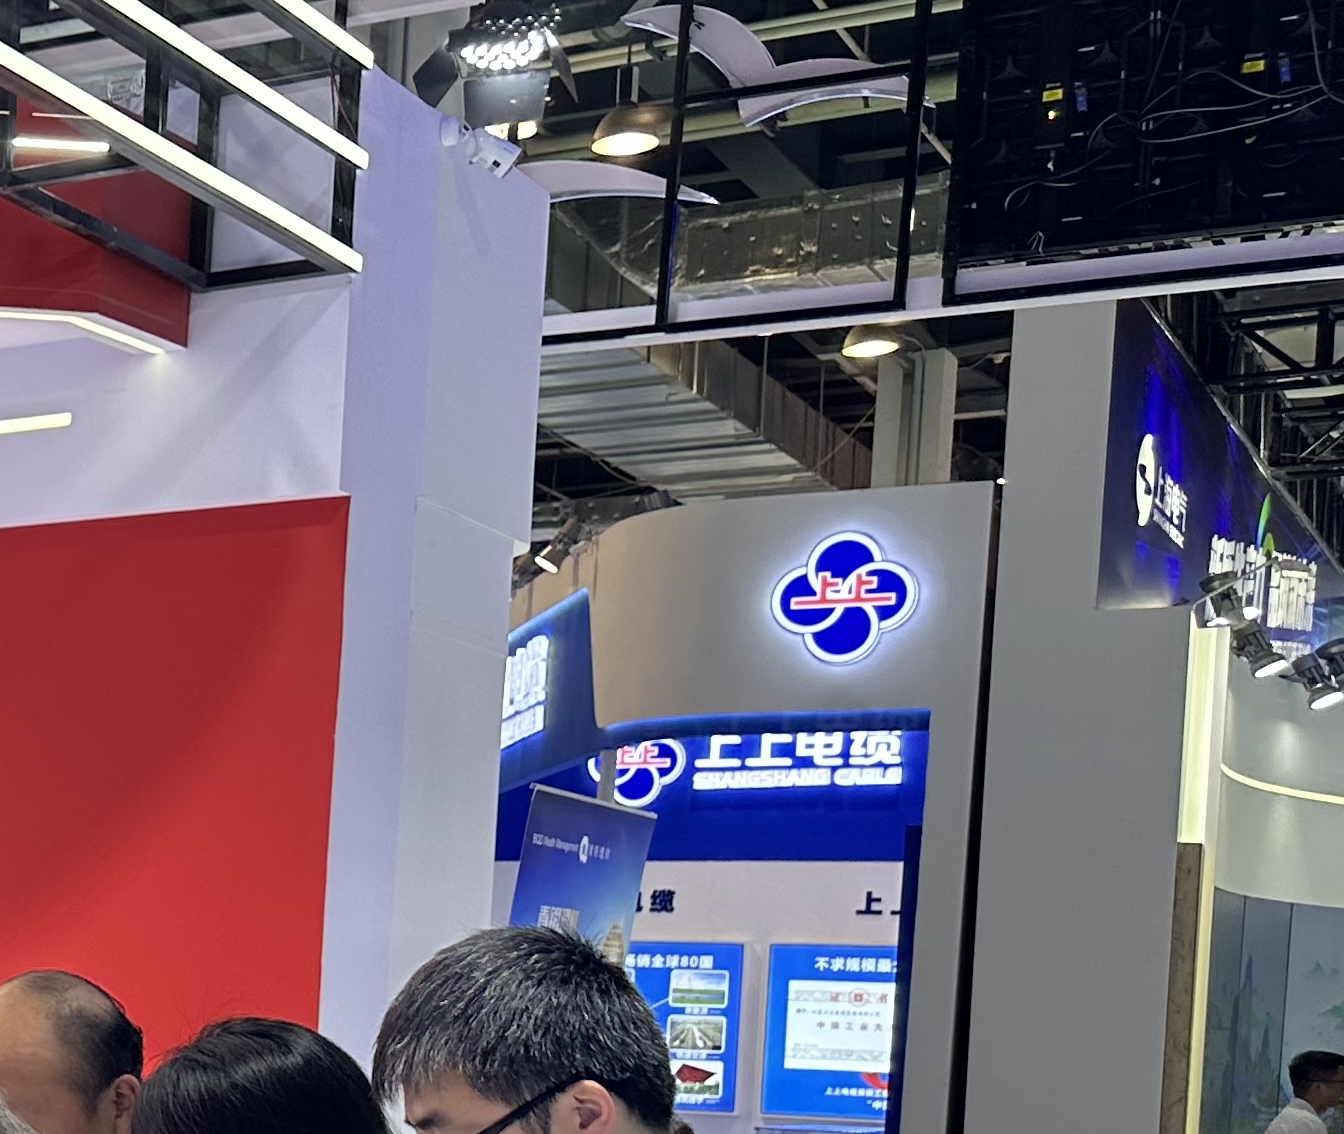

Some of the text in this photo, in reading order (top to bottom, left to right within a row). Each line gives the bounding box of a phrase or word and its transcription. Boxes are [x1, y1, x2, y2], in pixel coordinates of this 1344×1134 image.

[694, 730, 902, 768] 上上电缆
[692, 766, 902, 790] SHANGSHANG CABLE
